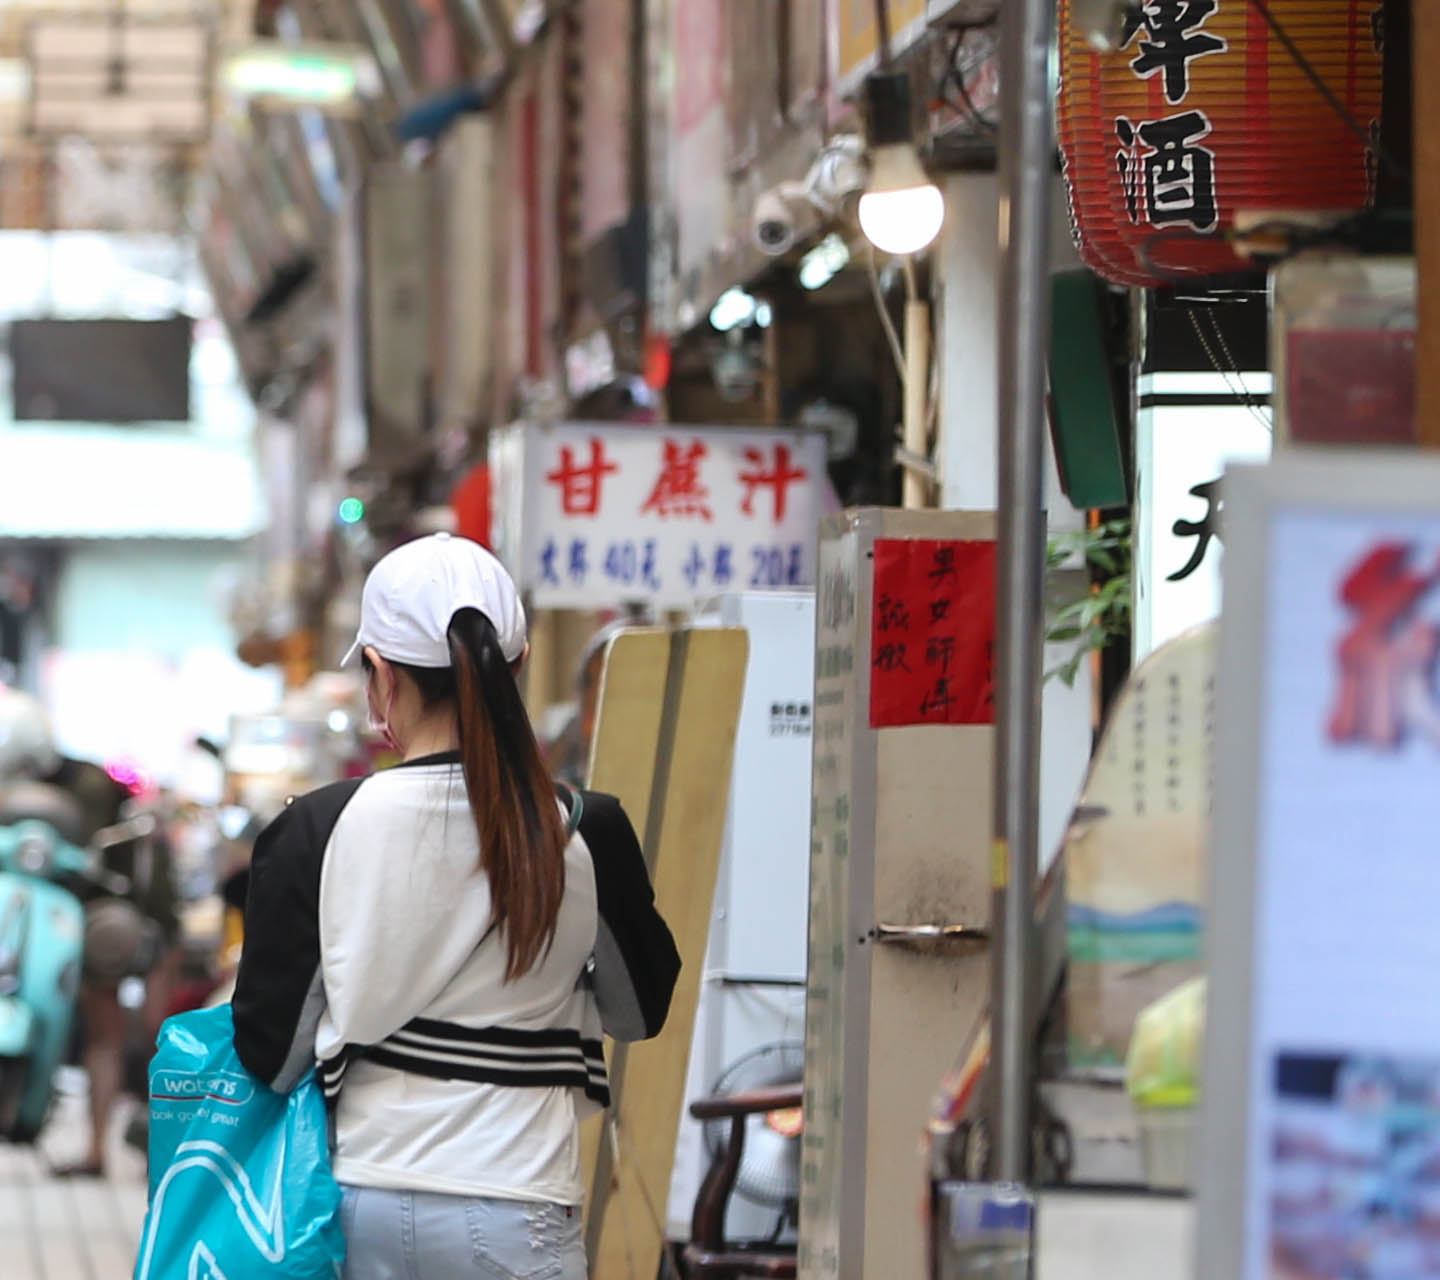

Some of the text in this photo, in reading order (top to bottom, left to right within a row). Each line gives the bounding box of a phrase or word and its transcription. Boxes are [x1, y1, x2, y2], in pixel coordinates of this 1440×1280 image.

[546, 436, 808, 524] 甘蔗汁
[164, 1078, 237, 1096] watons
